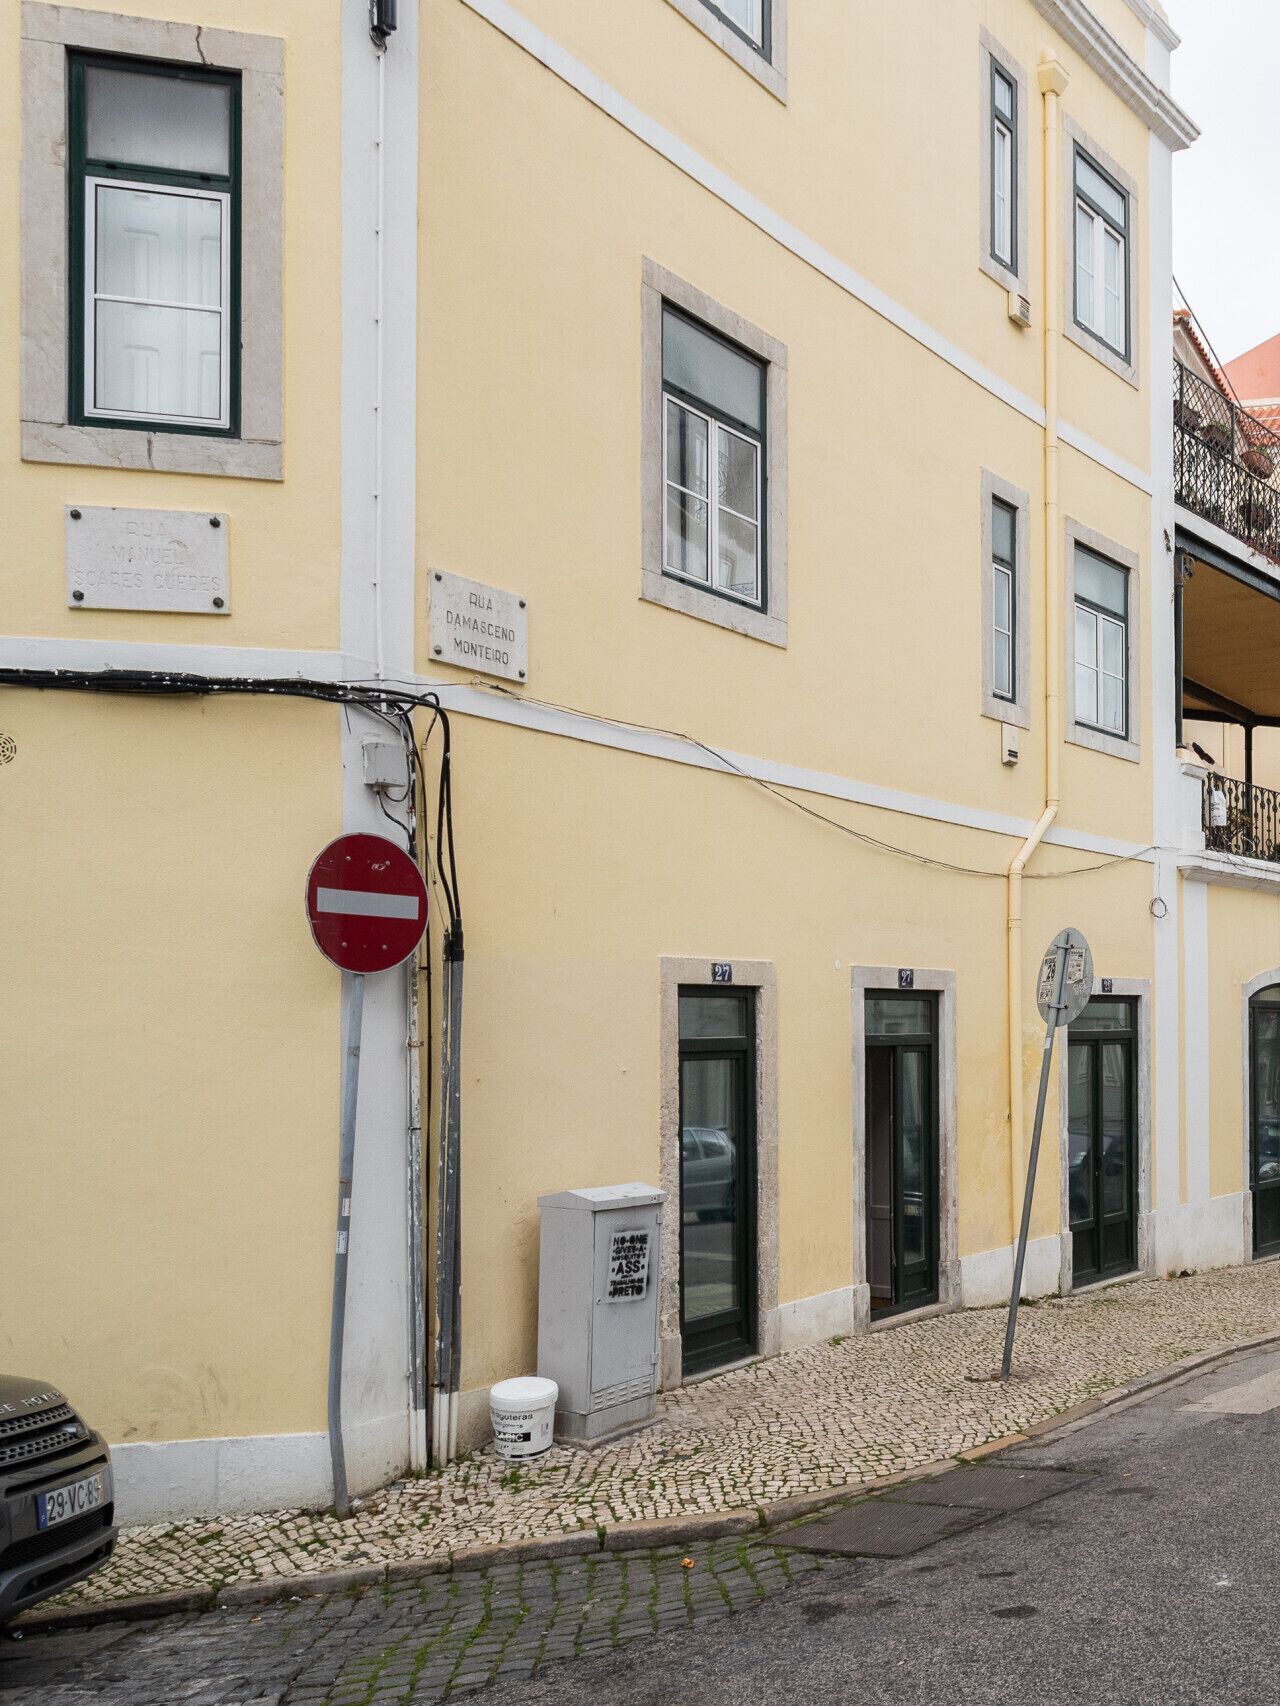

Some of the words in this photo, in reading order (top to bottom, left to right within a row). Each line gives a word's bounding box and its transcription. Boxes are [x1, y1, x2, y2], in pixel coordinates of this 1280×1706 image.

[126, 520, 168, 538] RUA
[112, 545, 185, 566] MANUEL
[73, 570, 144, 589] SOARES
[153, 573, 222, 593] GUEDES
[469, 592, 493, 611] RUA
[446, 610, 515, 642] DAMASCENO
[453, 637, 509, 665] MONTEIRO
[714, 964, 730, 981] 27
[900, 970, 912, 986] 27
